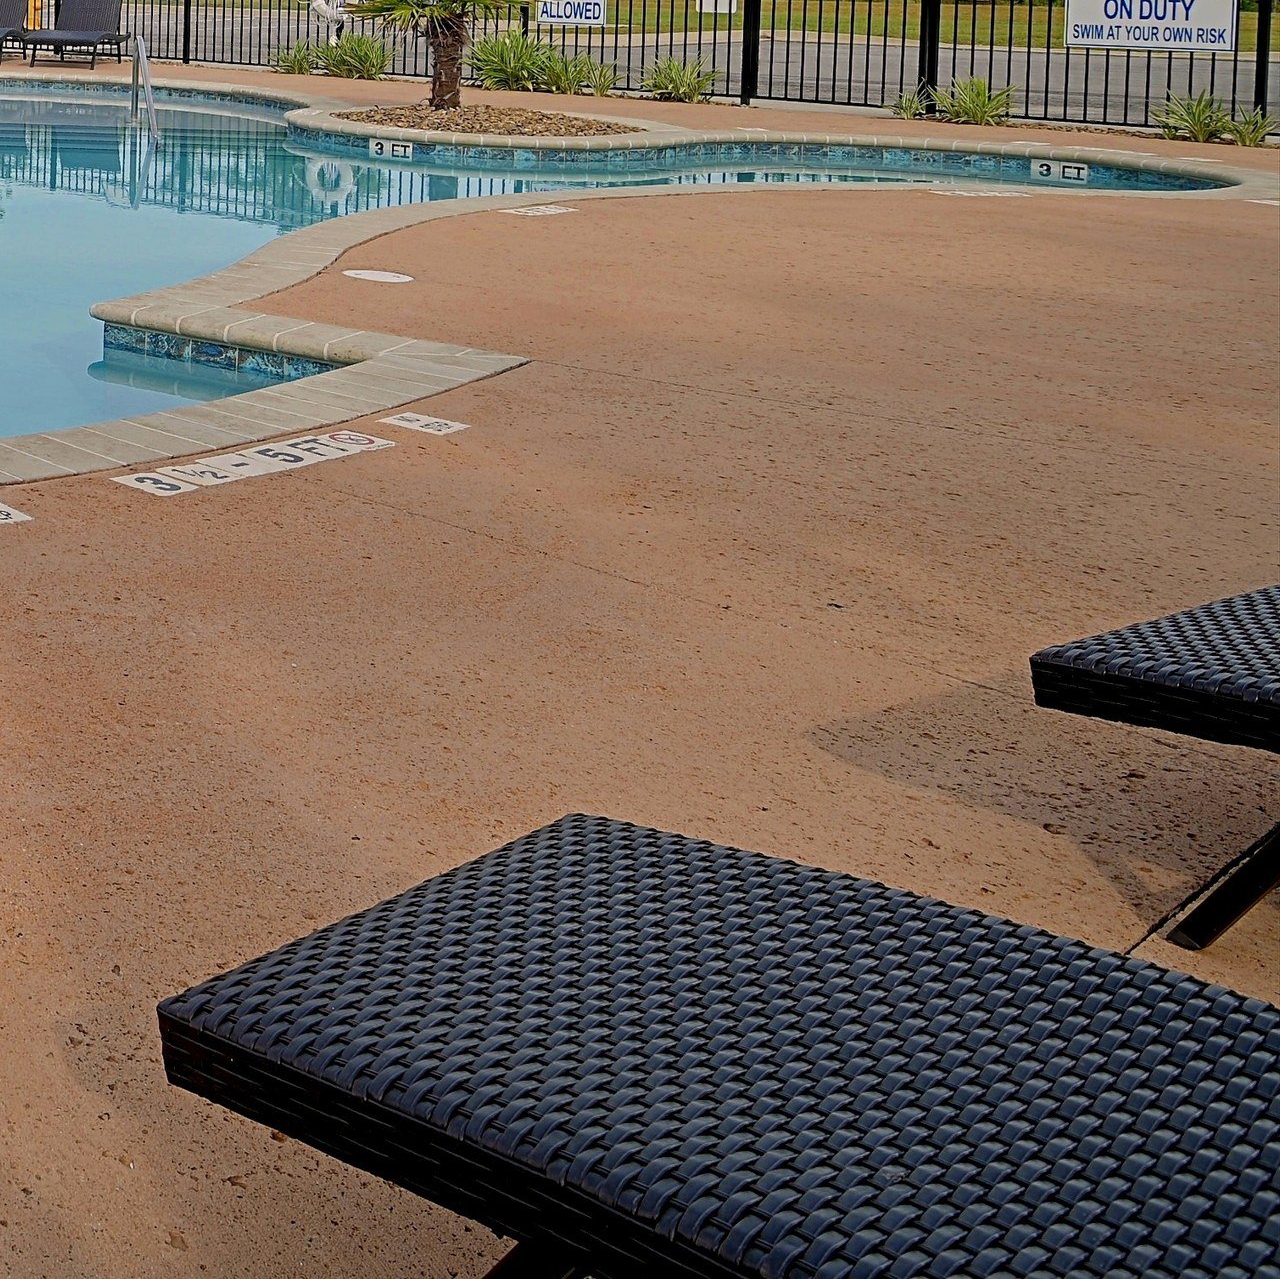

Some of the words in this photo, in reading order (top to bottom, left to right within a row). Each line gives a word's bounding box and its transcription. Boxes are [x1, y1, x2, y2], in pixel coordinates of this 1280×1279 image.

[540, 1, 601, 20] ALLOWED
[1072, 23, 1104, 40] SWIM
[1106, 25, 1122, 40] AT
[1125, 26, 1159, 42] YOUR
[1162, 26, 1192, 43] OWN
[1196, 28, 1227, 44] RISK
[135, 476, 181, 492] 3
[253, 448, 303, 464] 5
[294, 437, 350, 458] FT
